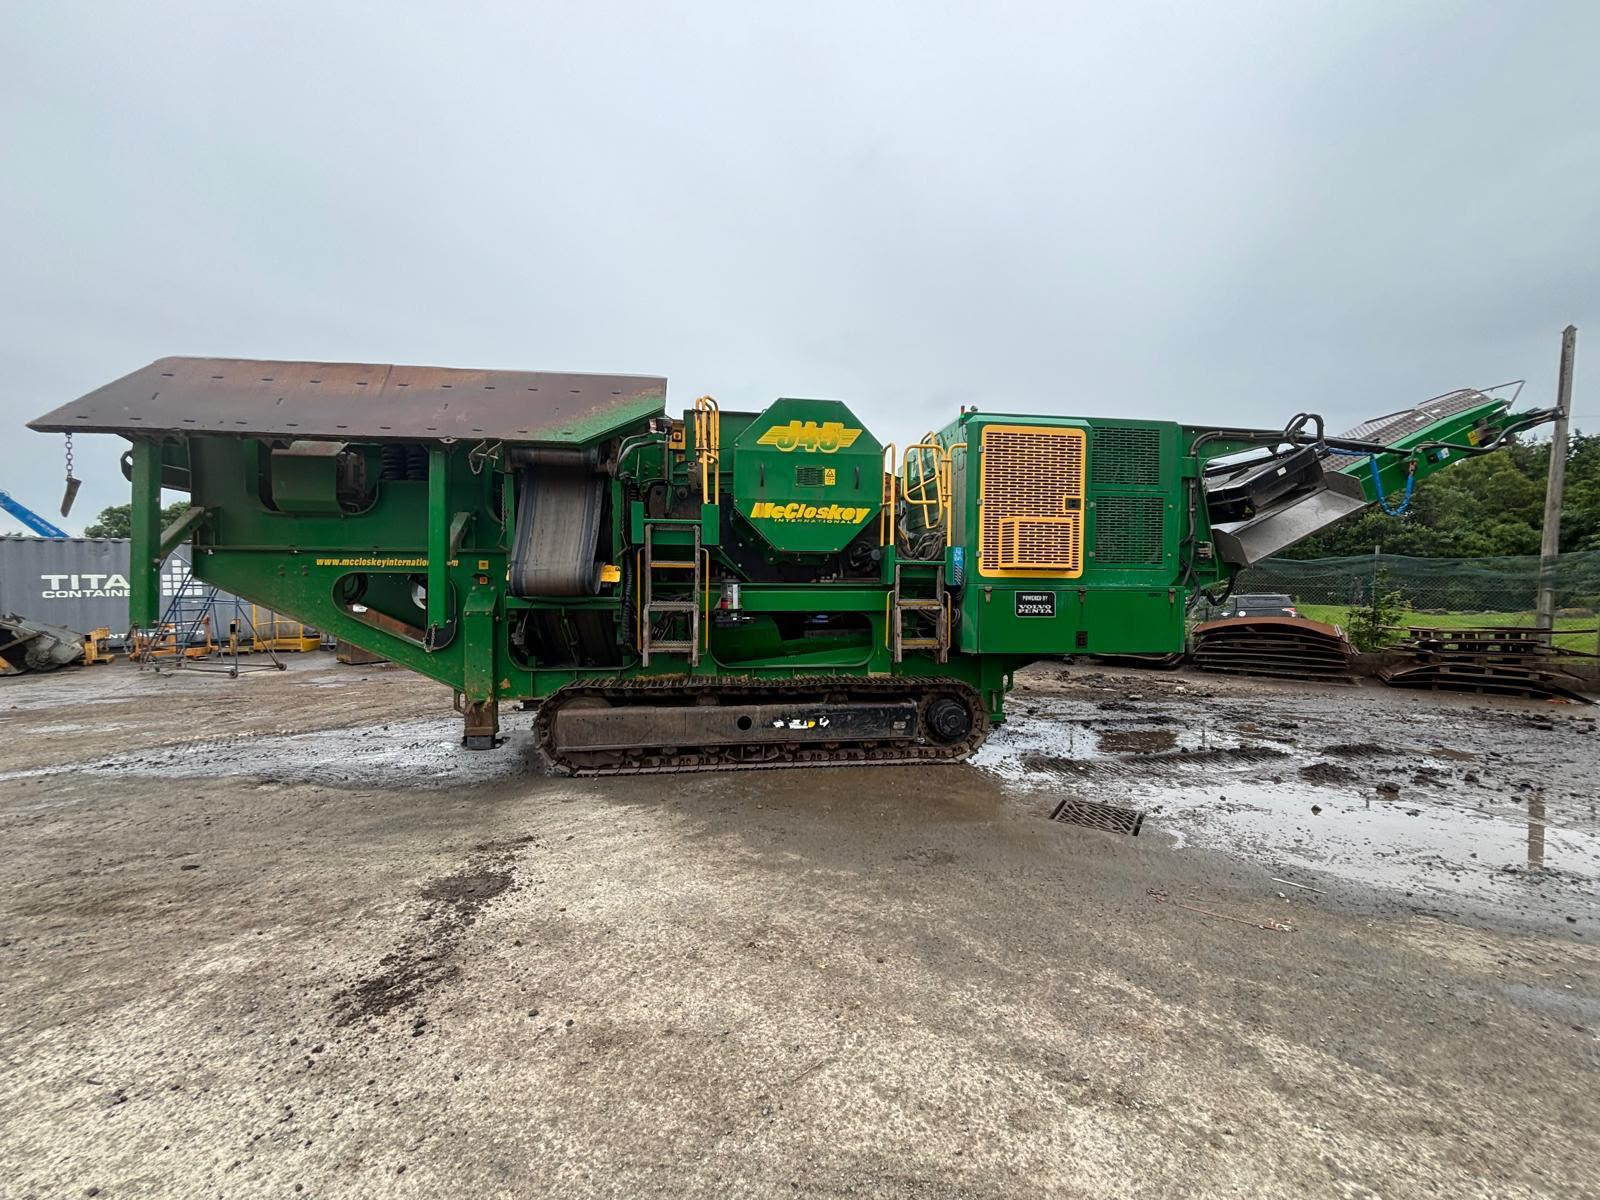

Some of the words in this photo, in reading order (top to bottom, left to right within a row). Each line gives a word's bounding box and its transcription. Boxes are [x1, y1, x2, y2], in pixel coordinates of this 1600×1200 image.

[775, 420, 844, 453] J45
[750, 502, 871, 524] McCloskey
[41, 574, 131, 590] TITA
[42, 589, 131, 598] CONTAINE
